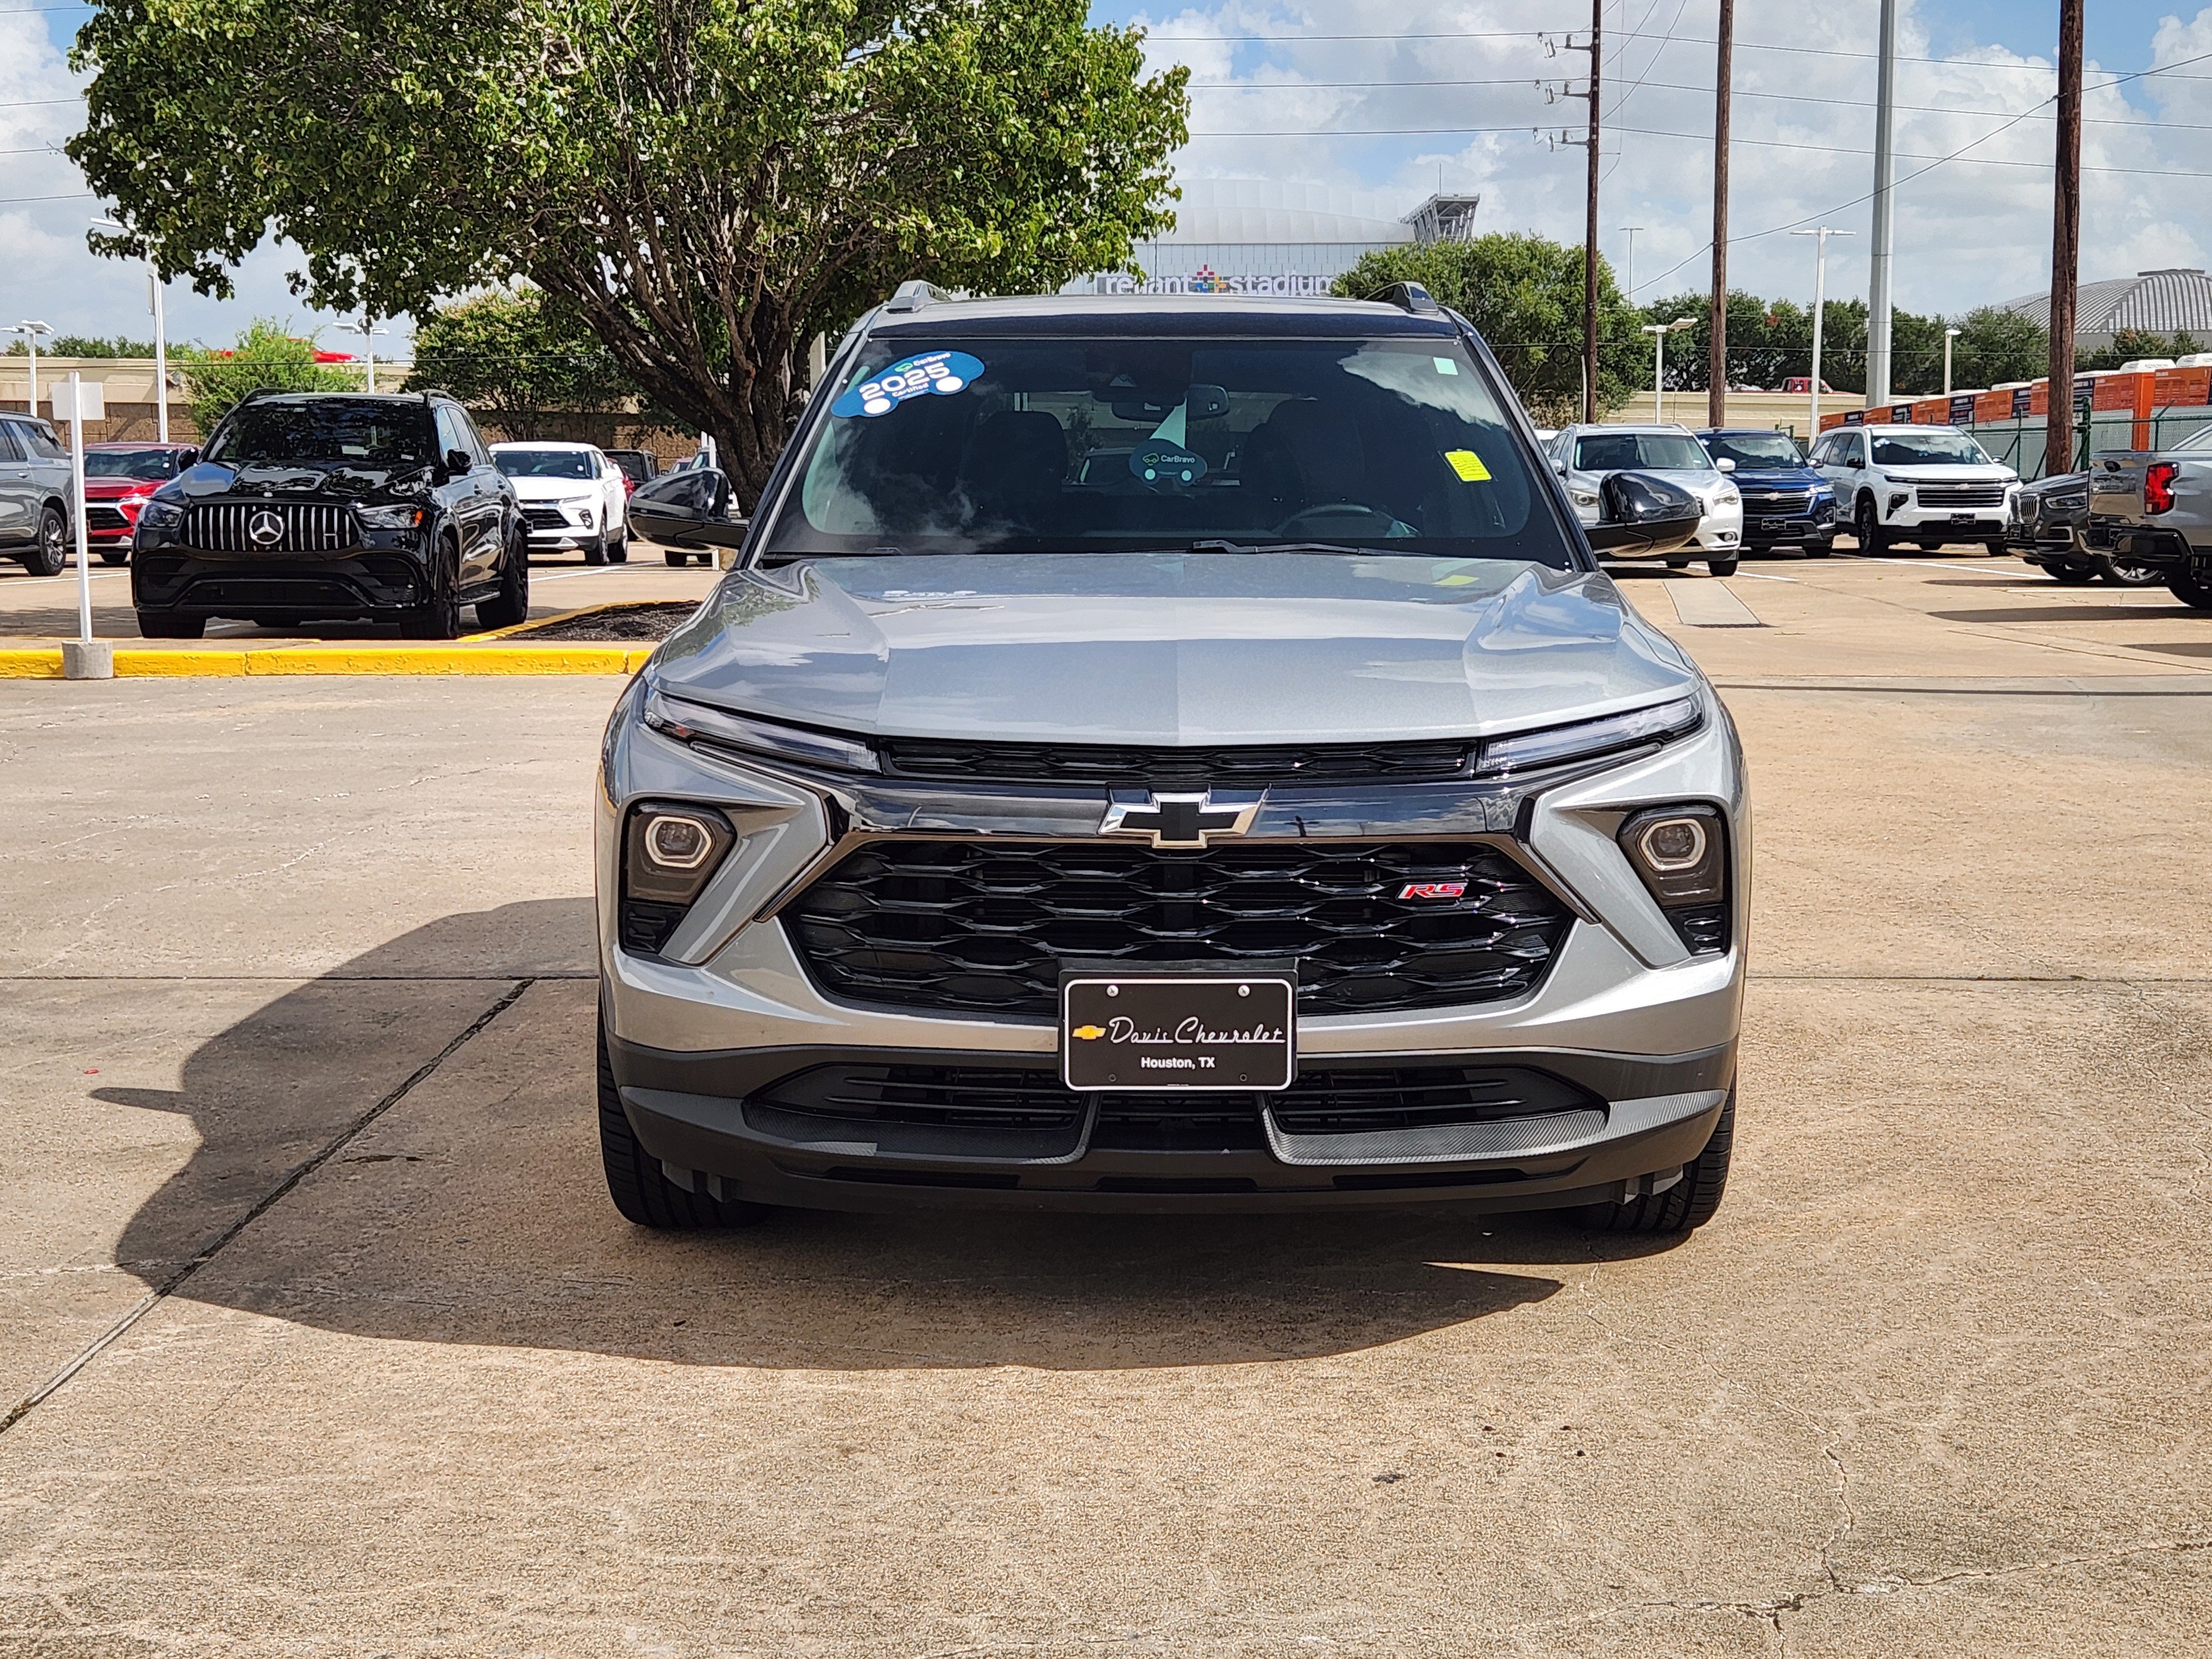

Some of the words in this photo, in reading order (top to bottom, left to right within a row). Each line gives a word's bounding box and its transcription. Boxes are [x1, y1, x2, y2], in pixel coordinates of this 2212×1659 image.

[1229, 269, 1338, 296] stadium
[859, 362, 950, 401] 2025
[1160, 455, 1196, 463] CarBravo
[1397, 882, 1468, 900] RS
[1108, 1016, 1174, 1044] Davis
[1175, 1016, 1286, 1044] Chevrolet
[1140, 1056, 1196, 1070] Houston,
[1198, 1056, 1216, 1068] TX
